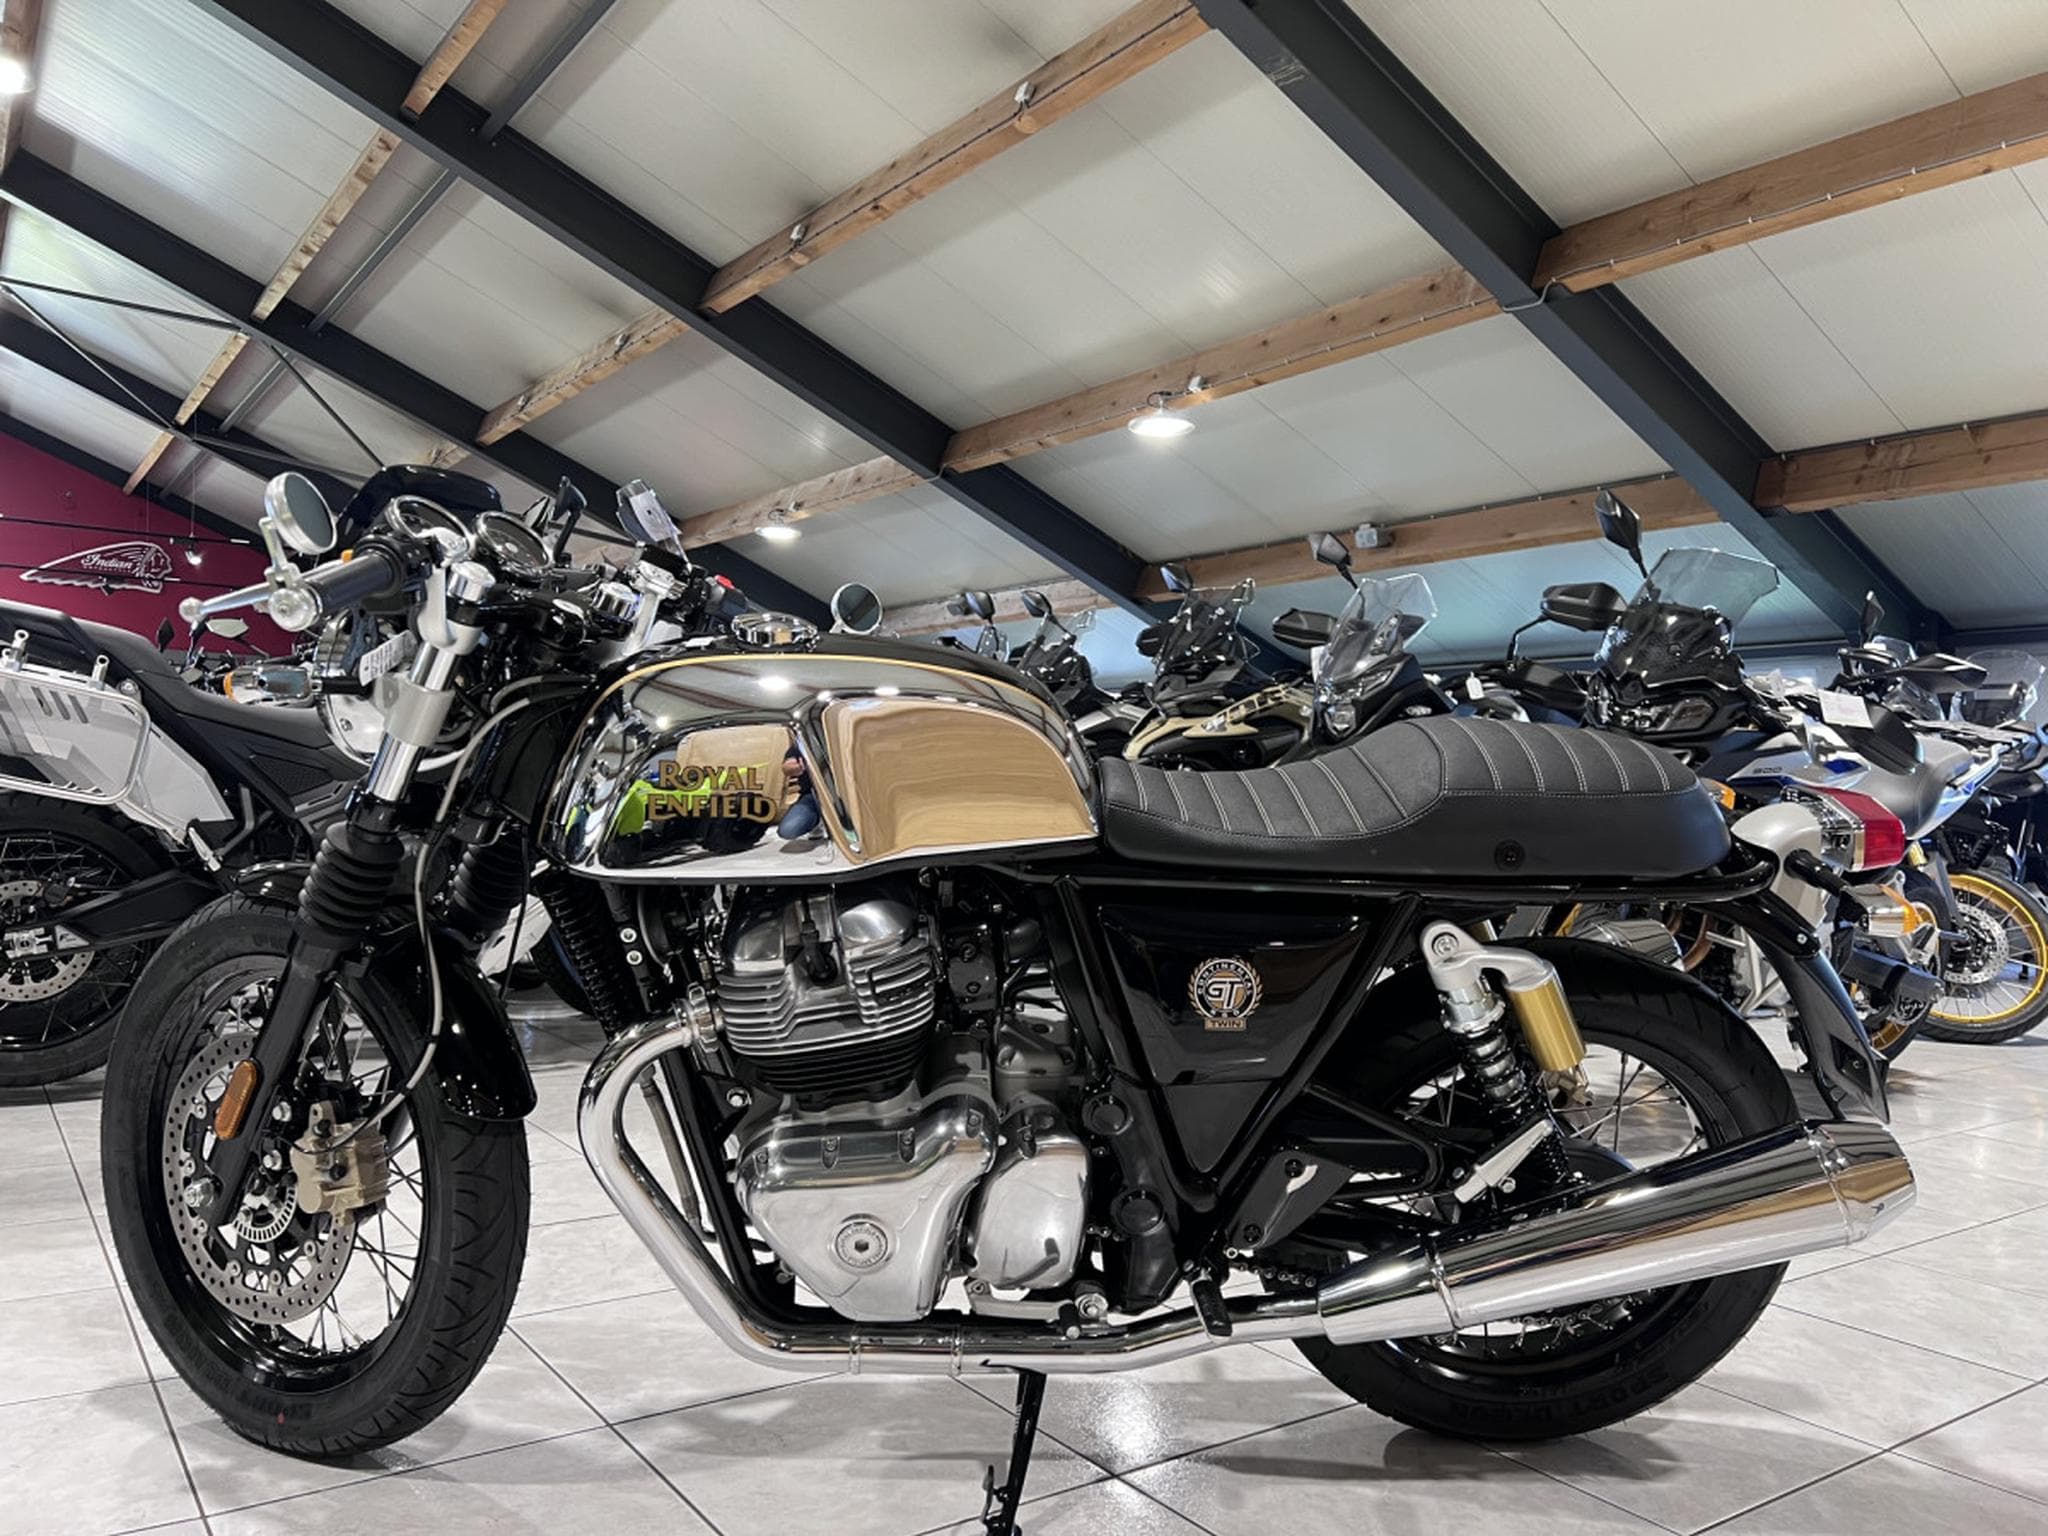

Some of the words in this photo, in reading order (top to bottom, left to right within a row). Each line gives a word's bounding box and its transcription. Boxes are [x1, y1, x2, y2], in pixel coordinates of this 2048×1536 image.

[81, 554, 132, 568] Indian
[658, 759, 764, 791] ROYAL
[647, 792, 778, 824] ENFIELD
[1205, 977, 1244, 1010] GT
